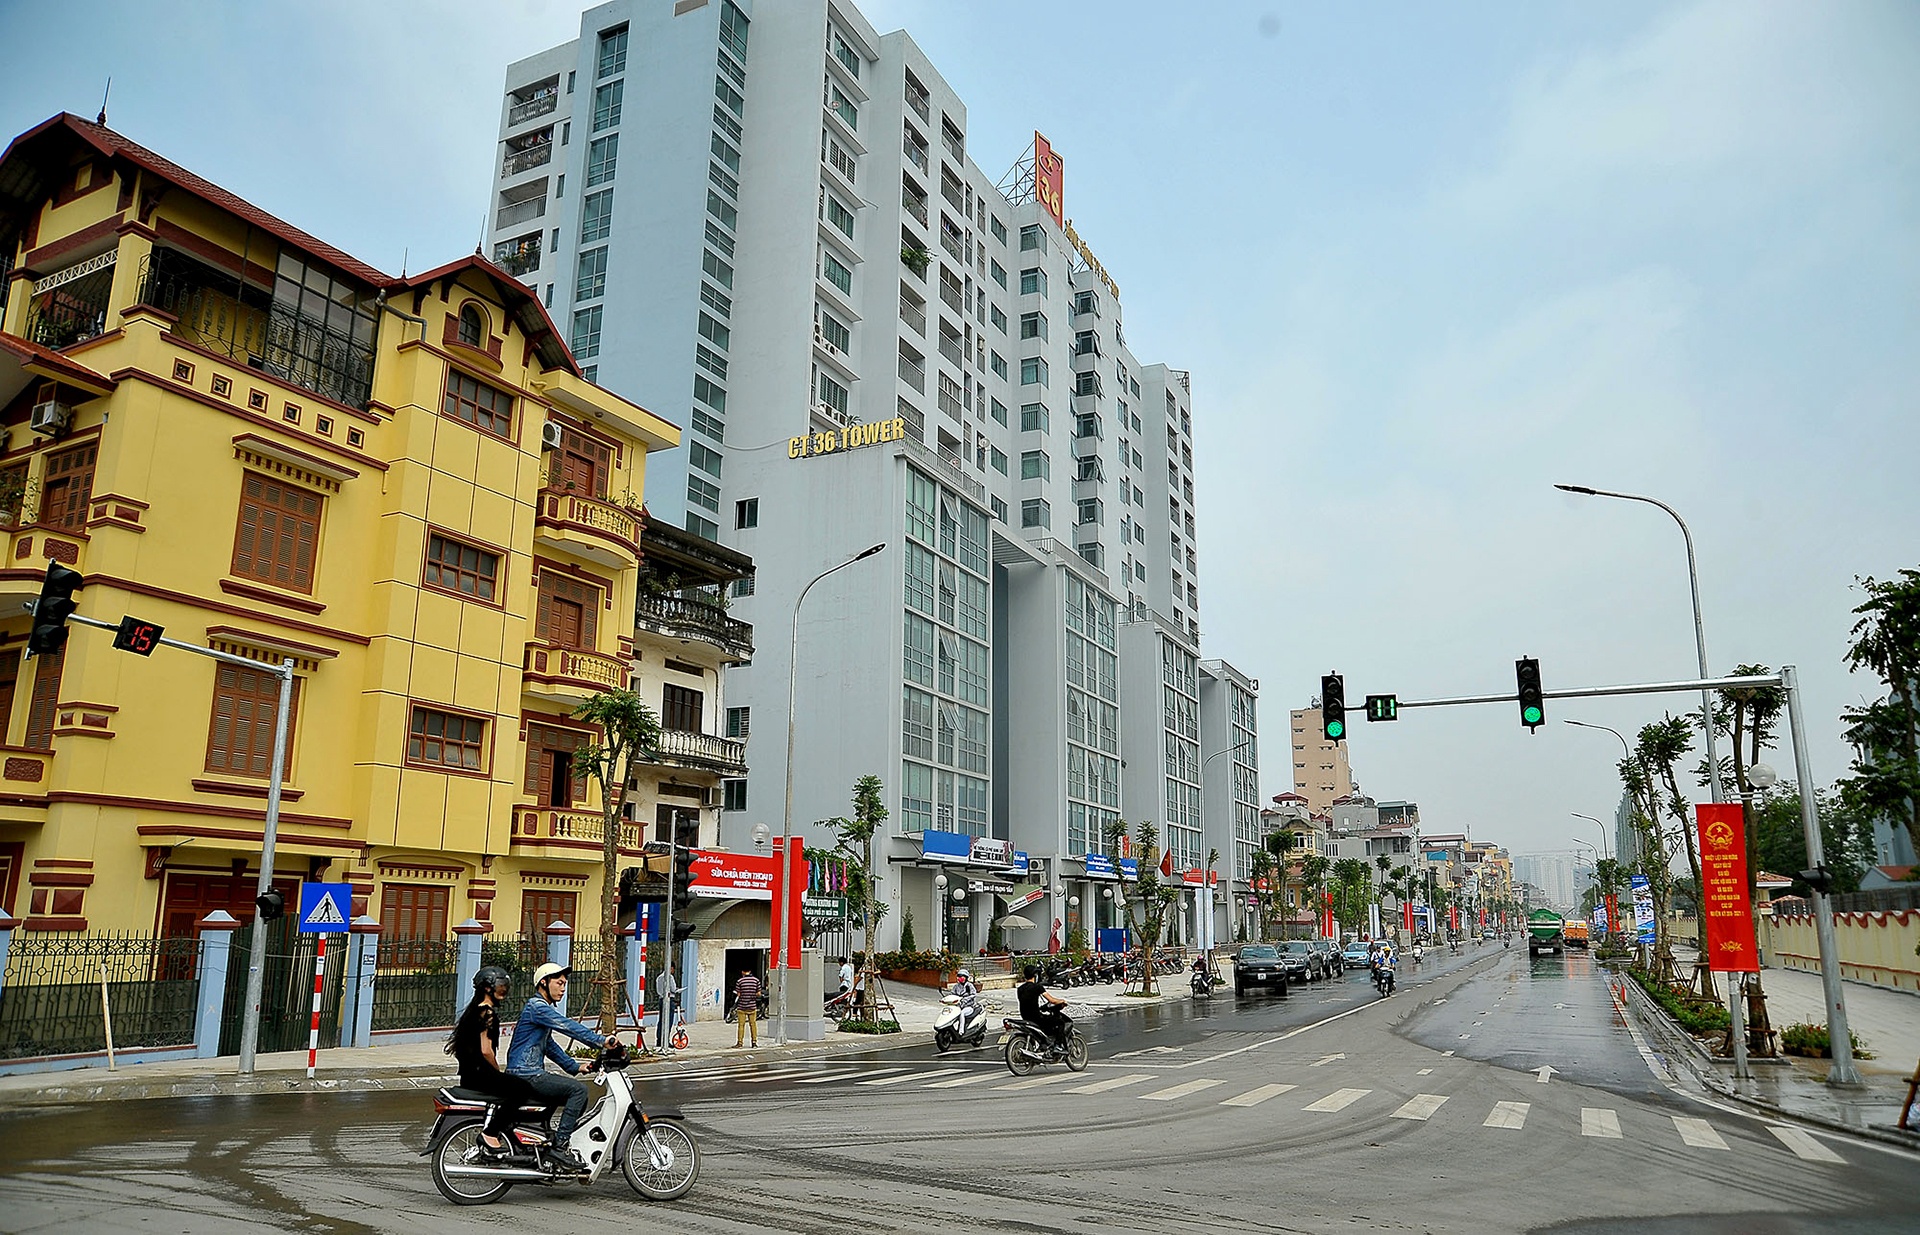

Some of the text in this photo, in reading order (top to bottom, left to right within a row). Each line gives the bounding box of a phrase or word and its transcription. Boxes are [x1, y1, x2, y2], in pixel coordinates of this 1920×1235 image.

[1040, 175, 1060, 217] 36
[788, 417, 905, 459] CT 36 TOWER
[130, 625, 154, 651] 15
[1376, 699, 1396, 717] 11
